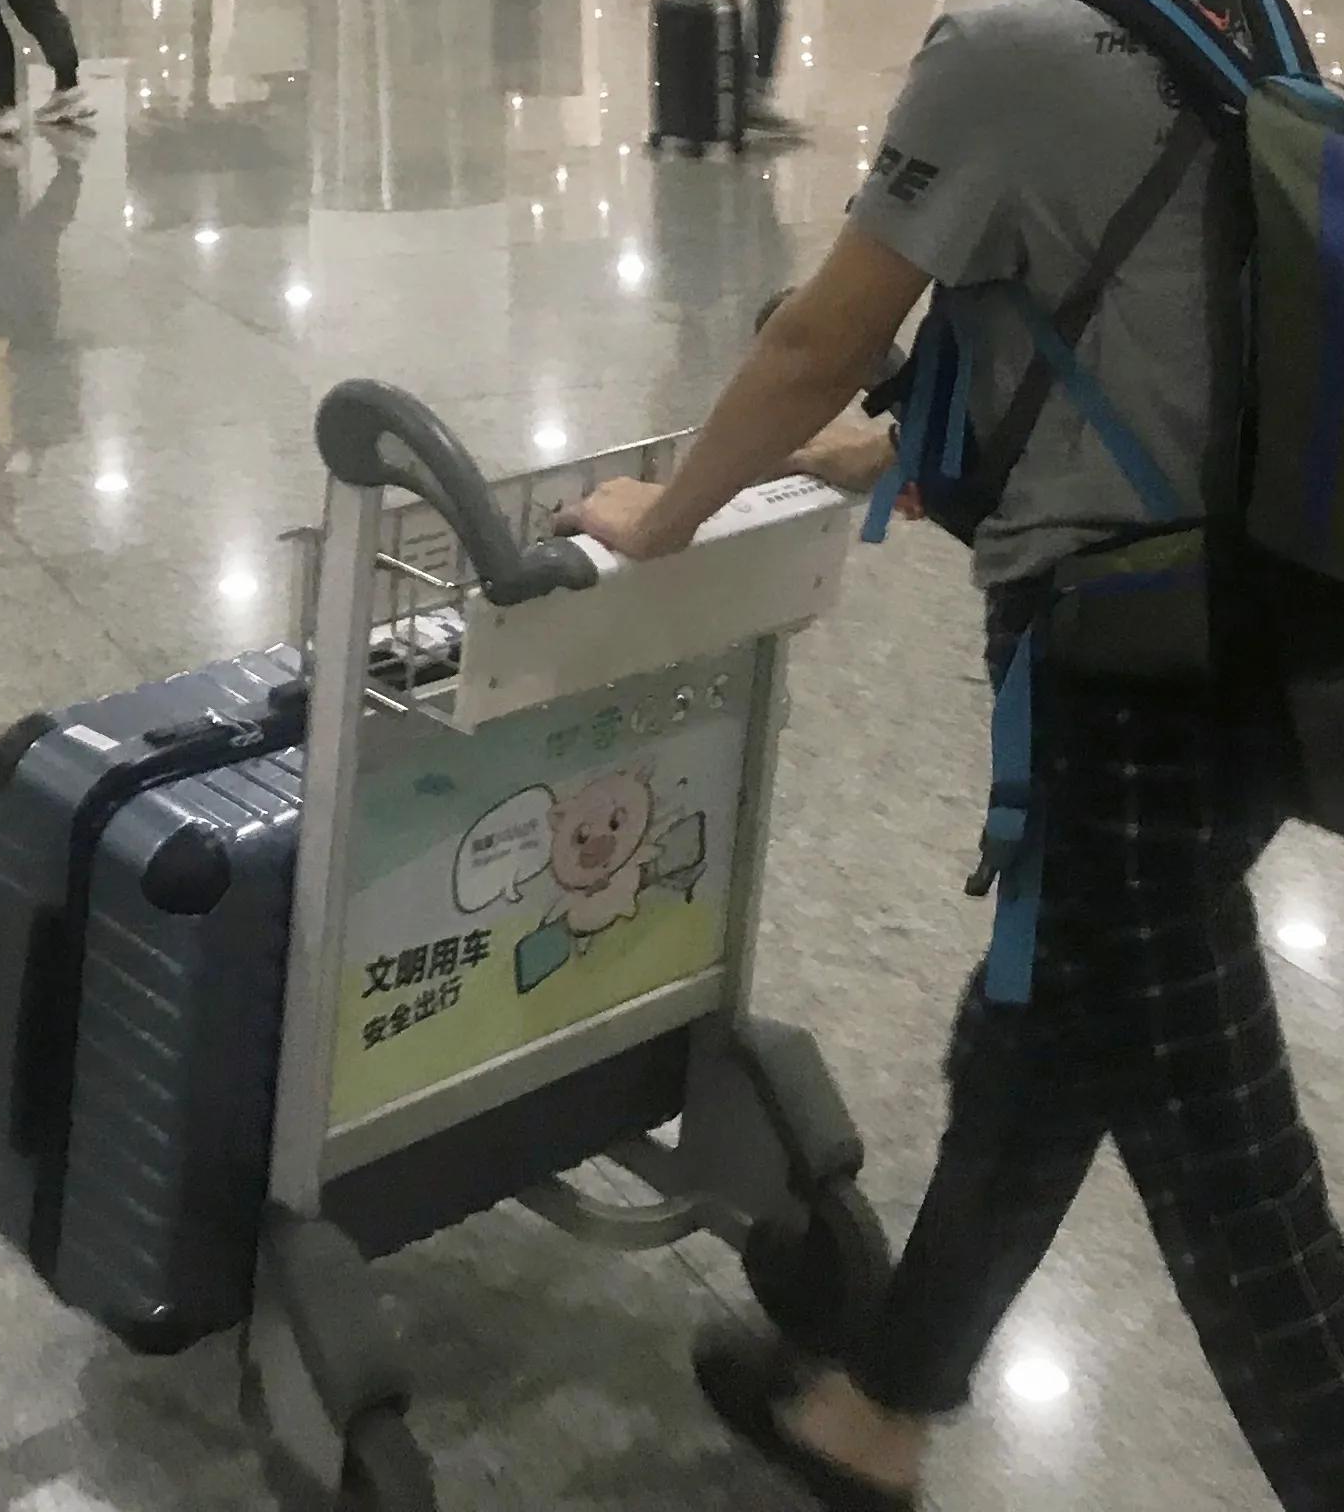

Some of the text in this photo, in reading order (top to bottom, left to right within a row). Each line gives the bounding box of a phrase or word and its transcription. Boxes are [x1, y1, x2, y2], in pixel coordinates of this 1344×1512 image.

[360, 928, 492, 999] 文明用车
[362, 974, 463, 1051] 安全出行
